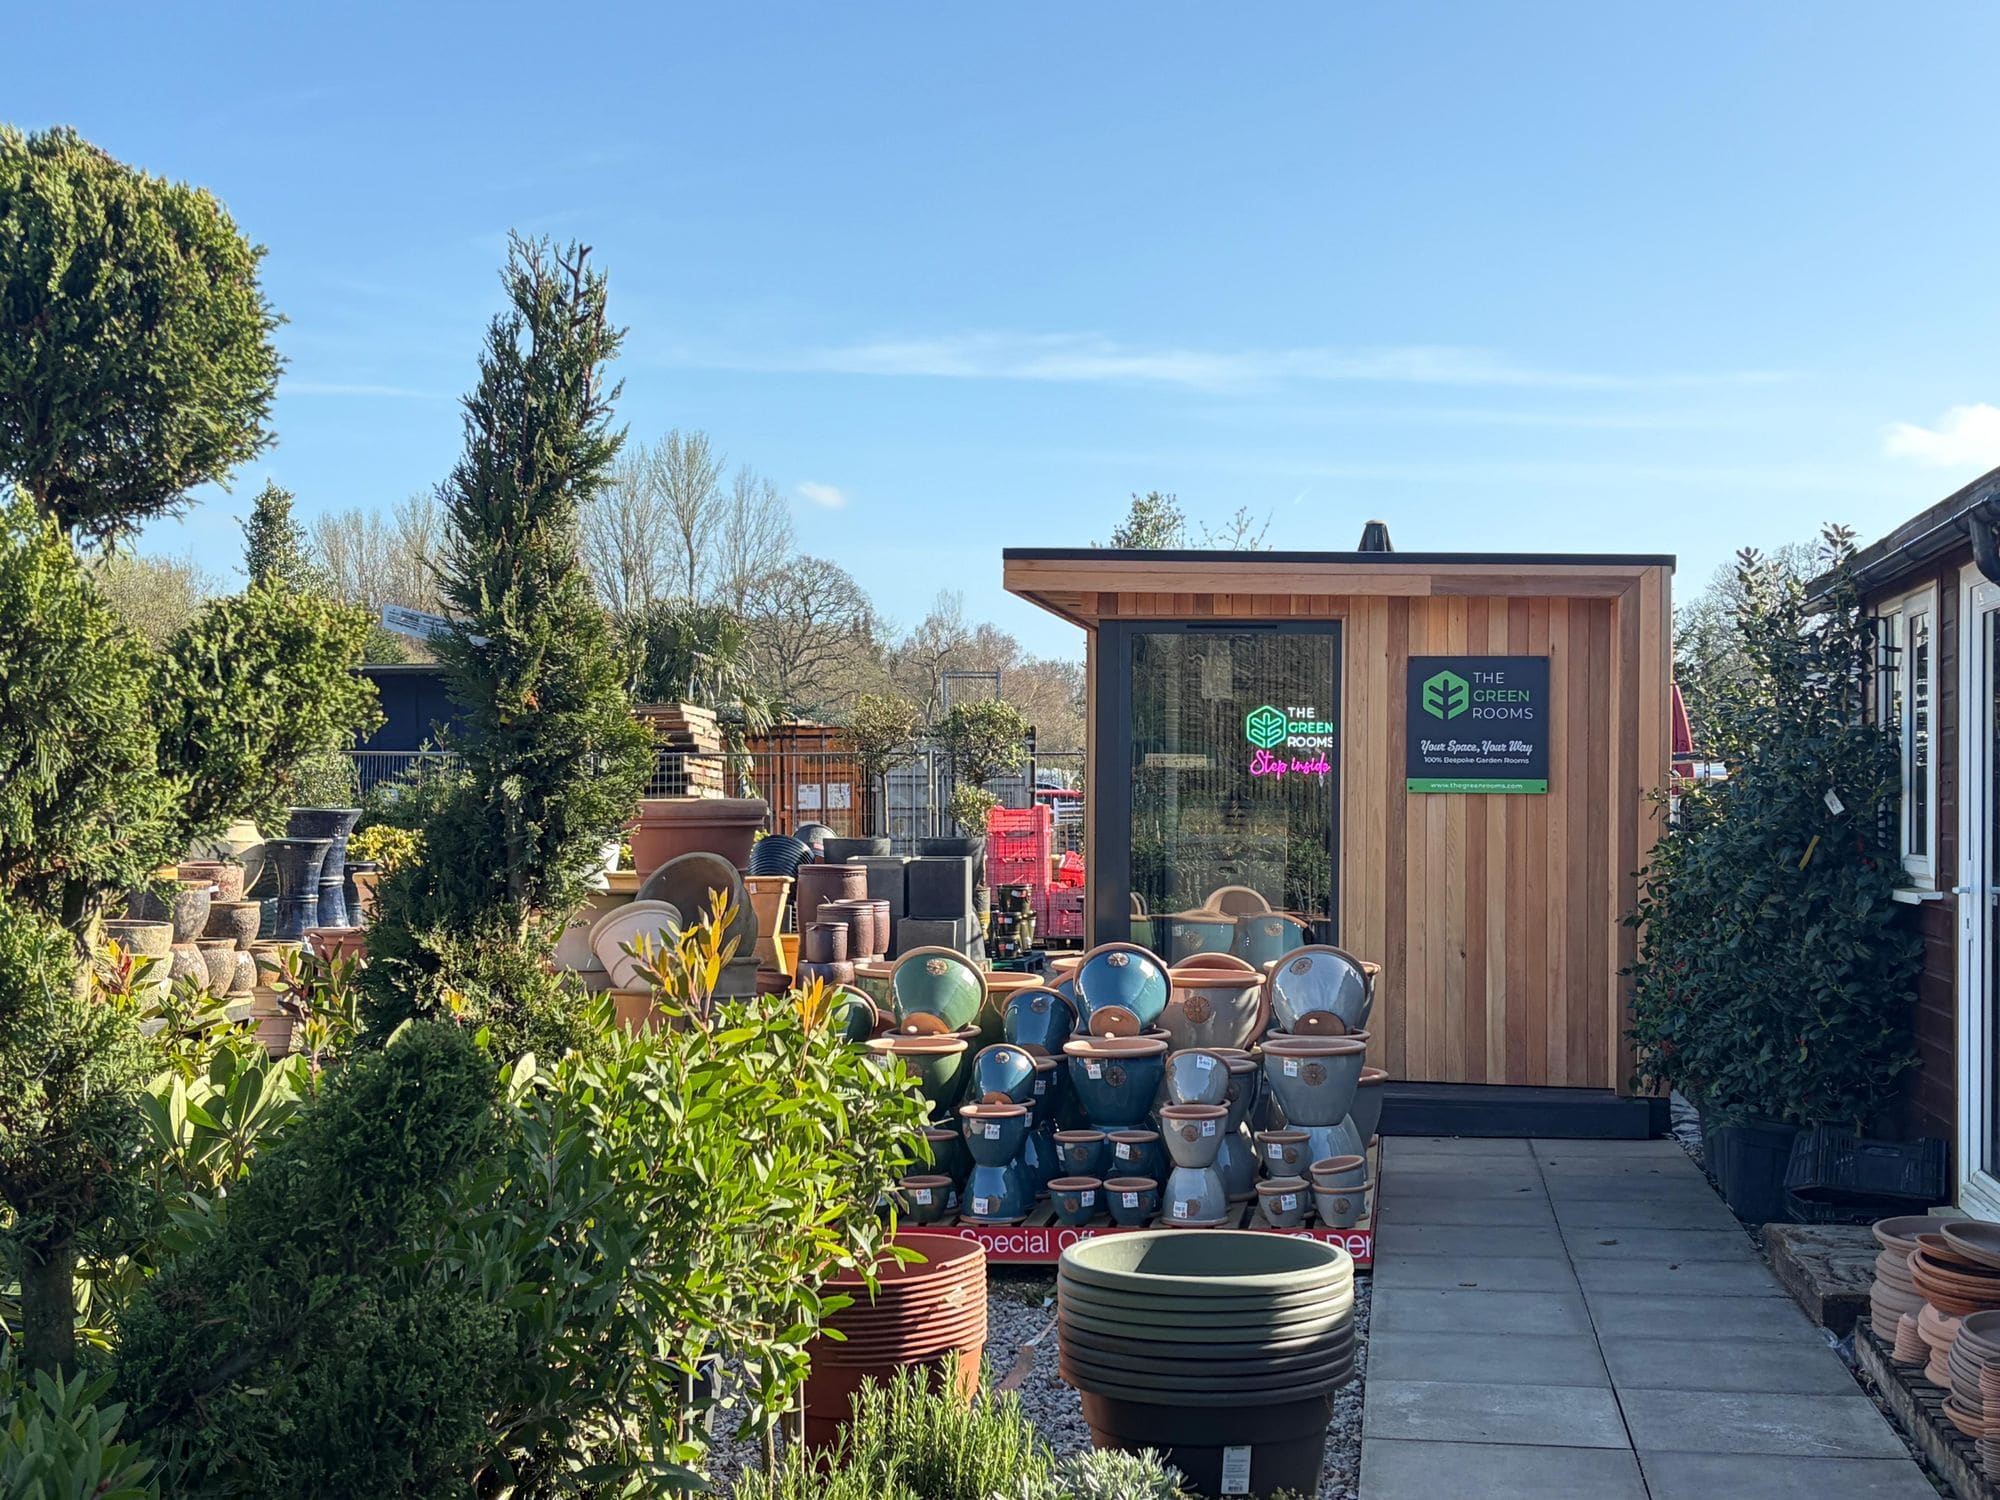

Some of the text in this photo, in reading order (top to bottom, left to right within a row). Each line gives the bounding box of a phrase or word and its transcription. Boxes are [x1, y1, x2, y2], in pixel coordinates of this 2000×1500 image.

[1473, 672, 1505, 684] THE
[1473, 690, 1530, 702] GREEN
[1287, 707, 1316, 719] THE
[1472, 708, 1534, 720] ROOMS
[1288, 722, 1333, 733] GREEN
[1287, 737, 1333, 748] ROOMS
[1420, 739, 1533, 756] Your Space, Your Way
[1250, 749, 1331, 780] Step inside
[1443, 756, 1475, 764] Bespoke
[1430, 782, 1523, 790] www.thegreenrooms.com
